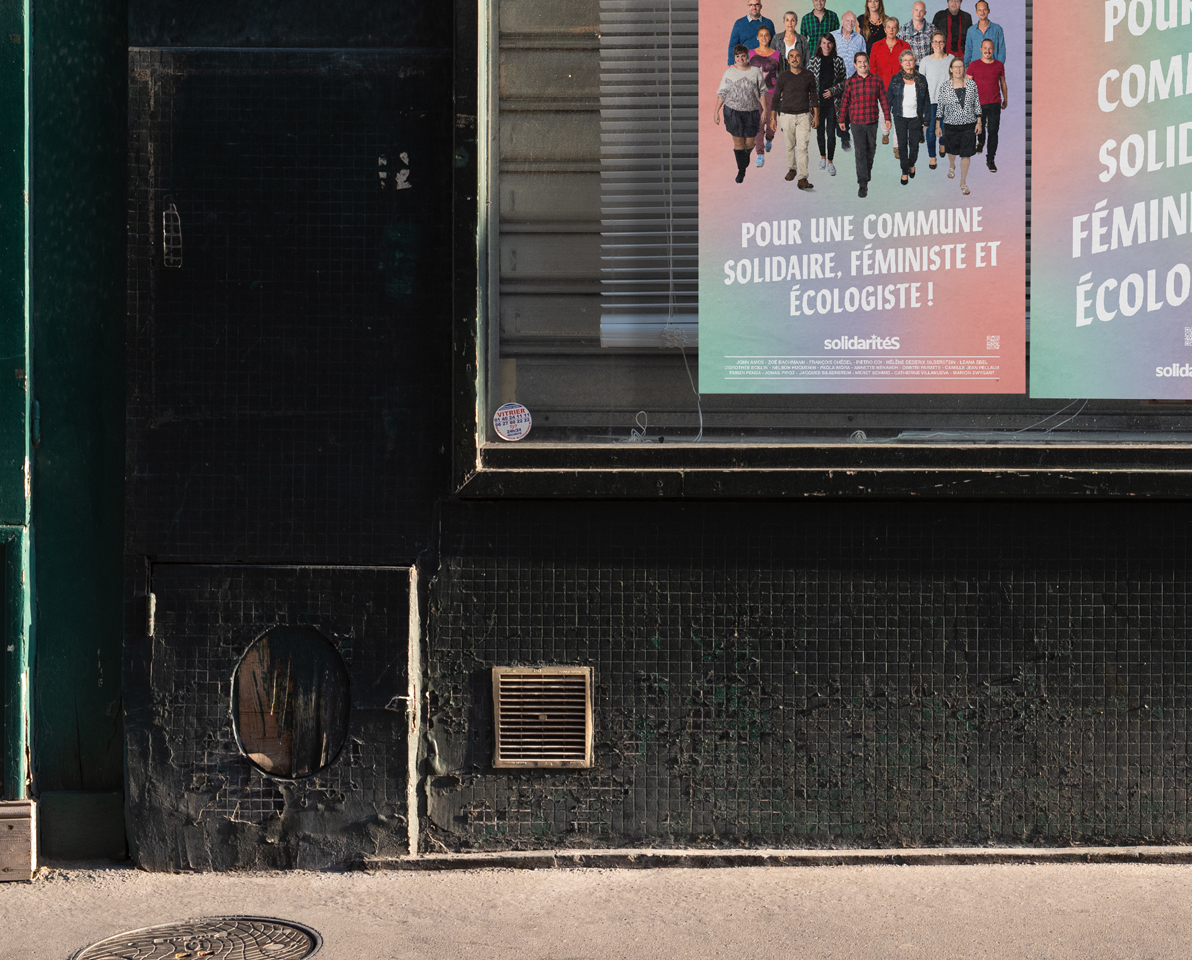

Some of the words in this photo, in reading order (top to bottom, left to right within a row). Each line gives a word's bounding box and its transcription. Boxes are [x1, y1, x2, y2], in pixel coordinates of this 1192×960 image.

[742, 219, 802, 248] POUR
[811, 215, 855, 243] UNE
[863, 206, 983, 239] COMMUNE
[724, 252, 842, 285] SOLIDAIRE,
[851, 243, 967, 276] FÉMINISTE
[976, 241, 1001, 267] ET
[790, 282, 921, 316] ÉCOLOGISTE
[927, 282, 933, 306] !
[497, 408, 525, 417] VITRIER
